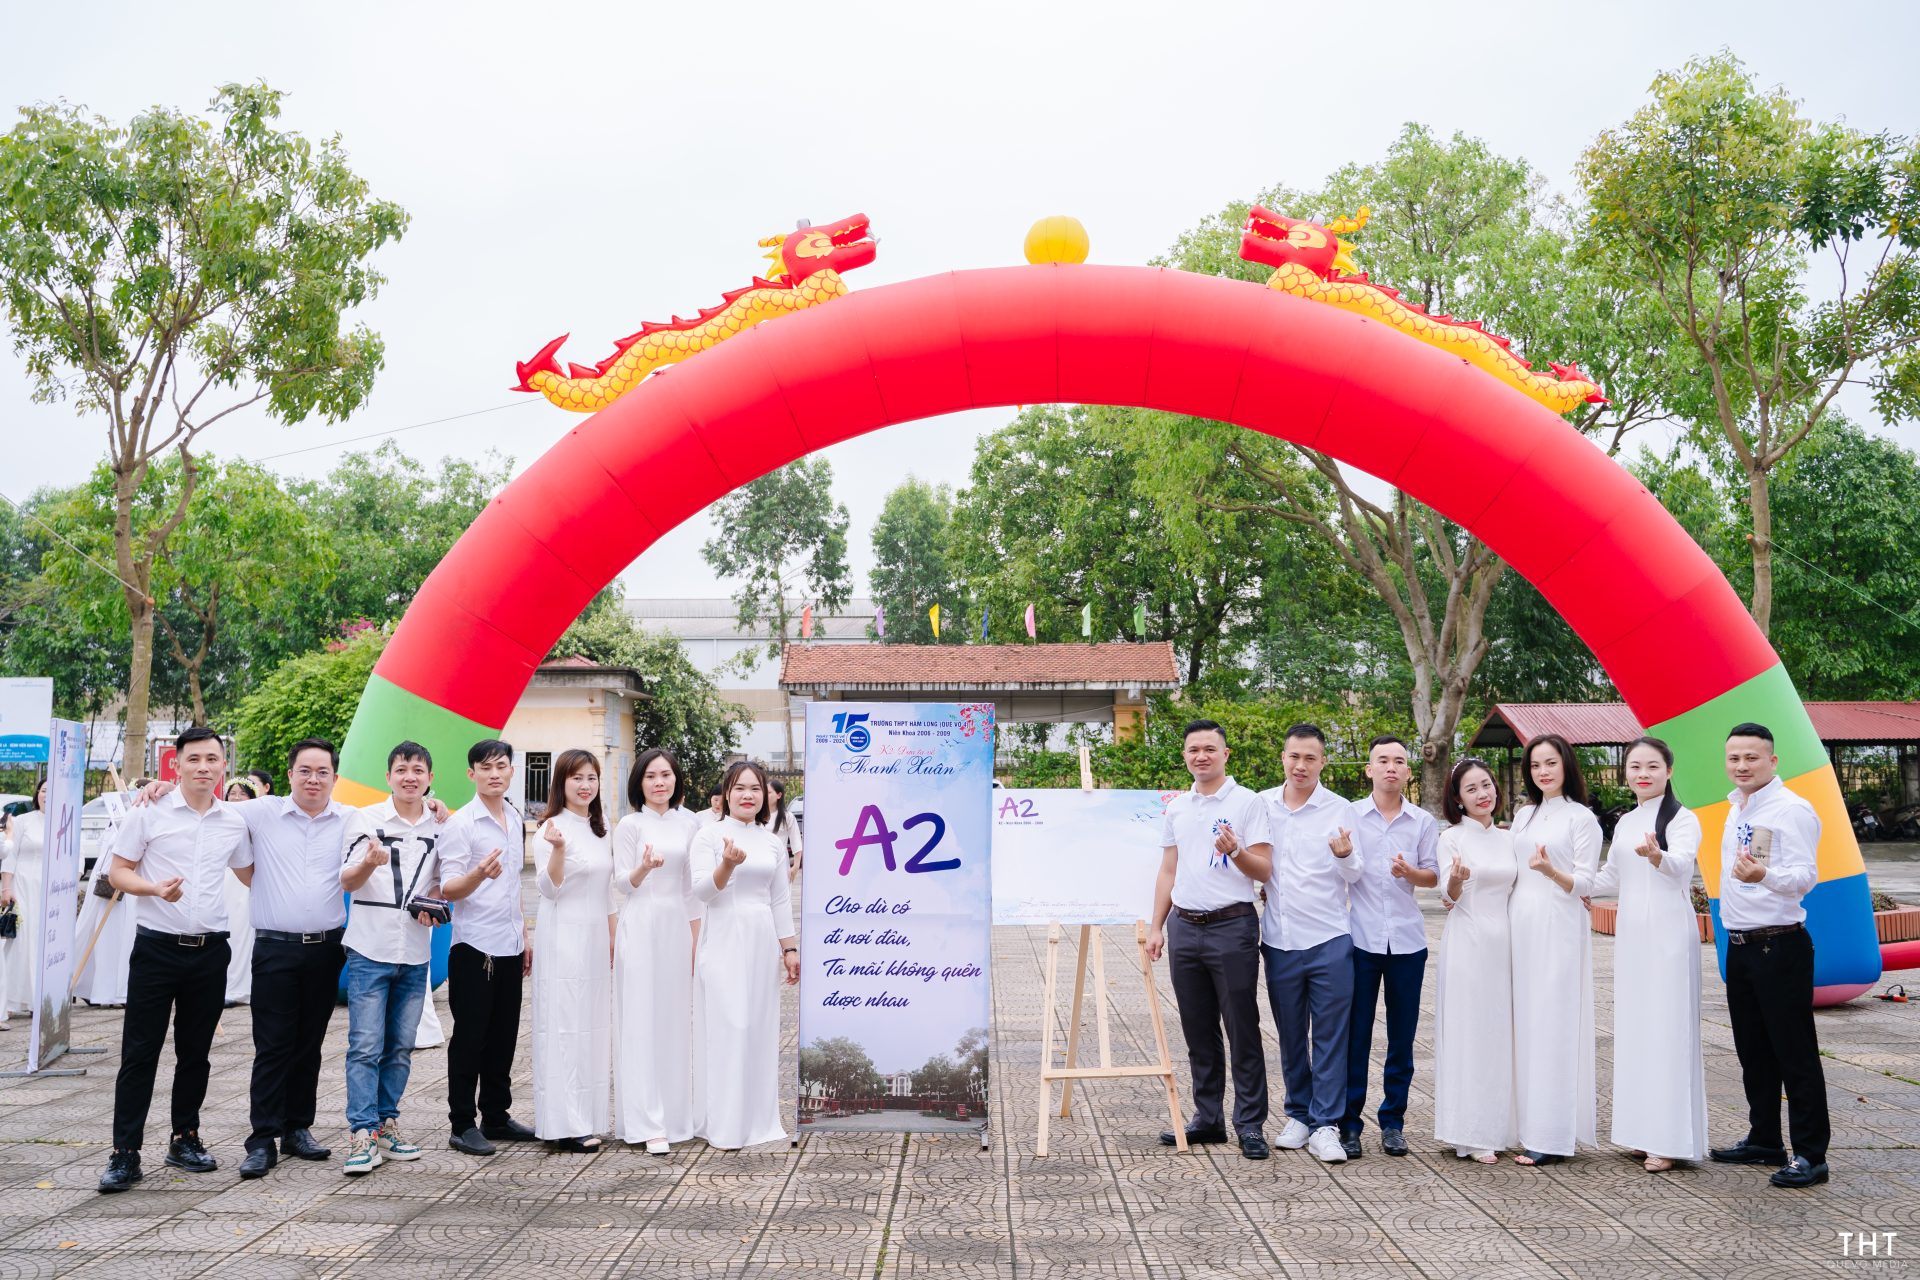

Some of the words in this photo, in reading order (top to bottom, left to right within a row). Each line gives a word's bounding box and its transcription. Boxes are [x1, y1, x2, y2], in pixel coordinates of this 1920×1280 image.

[923, 720, 938, 728] LONG
[840, 755, 900, 775] Thanh
[907, 755, 956, 775] Xuân
[999, 797, 1039, 818] A2
[835, 804, 961, 876] A2
[825, 895, 862, 914] Cho
[865, 898, 888, 914] dù
[891, 900, 912, 914] có
[824, 928, 843, 944] đi
[845, 930, 873, 945] nơi
[875, 929, 911, 947] đâu,
[823, 958, 846, 978] Ta
[849, 961, 884, 976] mãi
[885, 960, 938, 982] không
[941, 963, 982, 981] quên
[823, 990, 862, 1010] được
[865, 991, 910, 1007] nhau
